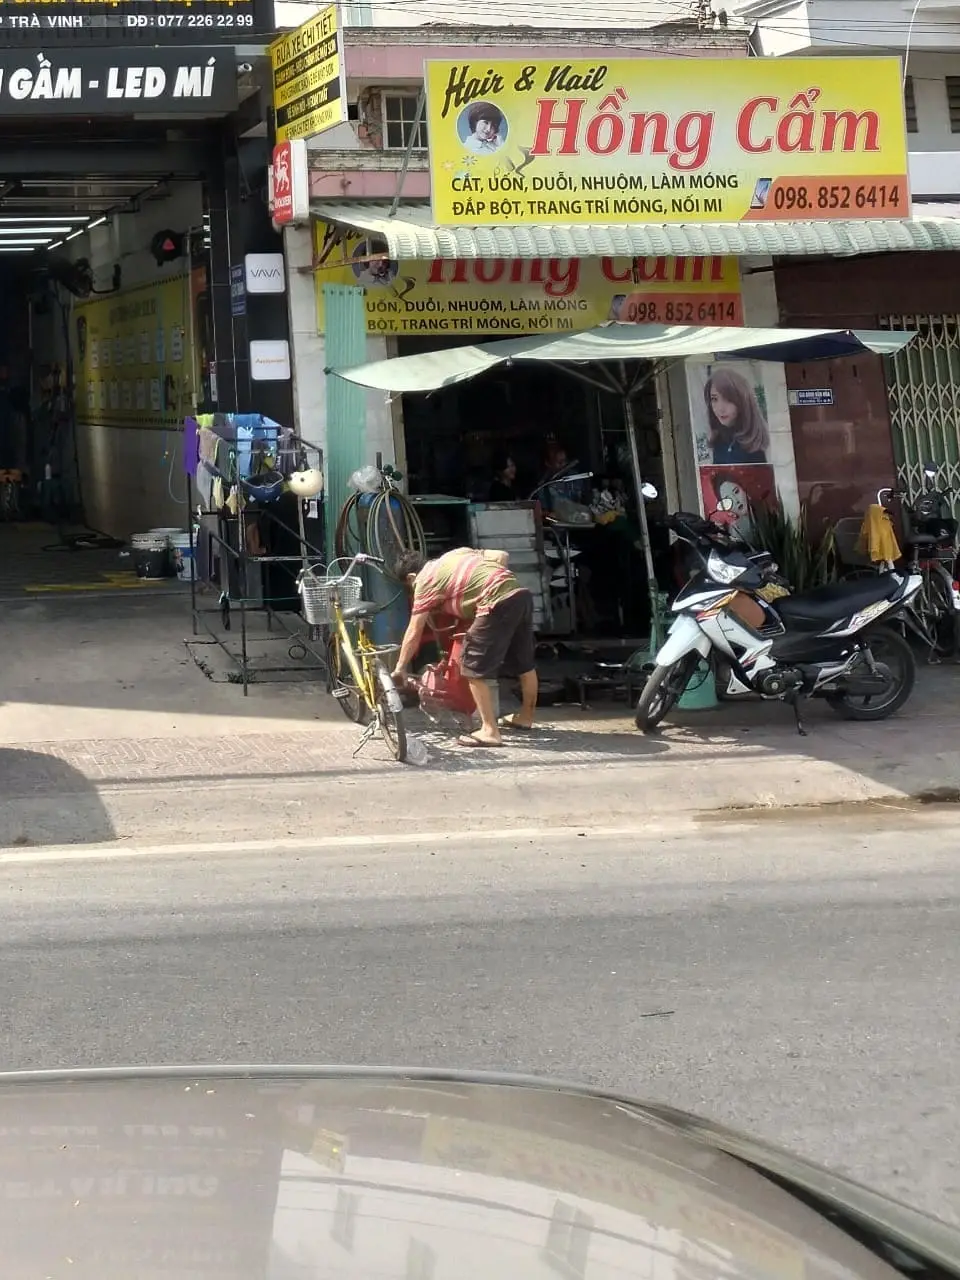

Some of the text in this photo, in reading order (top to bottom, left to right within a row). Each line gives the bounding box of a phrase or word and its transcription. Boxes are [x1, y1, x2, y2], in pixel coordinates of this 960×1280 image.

[9, 13, 41, 28] TRÀ
[47, 15, 83, 28] VINH
[157, 14, 183, 27] 077
[188, 14, 214, 27] 226
[217, 14, 234, 27] 22
[237, 14, 254, 27] 99
[8, 52, 83, 100] GẦM
[106, 67, 167, 99] LED
[172, 56, 217, 98] MÍ
[441, 64, 608, 119] Hair & Nail
[528, 86, 882, 172] Hồng Cẩm
[488, 172, 529, 193] UỐN,
[581, 174, 648, 193] NHUỘM,
[651, 172, 687, 191] LÀM
[689, 172, 739, 190] MÓNG
[452, 193, 723, 220] ĐẮP BỘT, TRANG TRÍ MÓNG, NỐI MI
[774, 184, 900, 210] 098. 852 6414
[448, 300, 507, 315] NHUỘM,
[510, 298, 540, 312] LÀM
[544, 296, 588, 311] MÓNG
[627, 301, 736, 322] 098. 852 6414
[401, 318, 449, 330] TRANG
[453, 316, 474, 330] TRÍ
[476, 316, 525, 331] MÓNG,
[556, 317, 574, 329] MI
